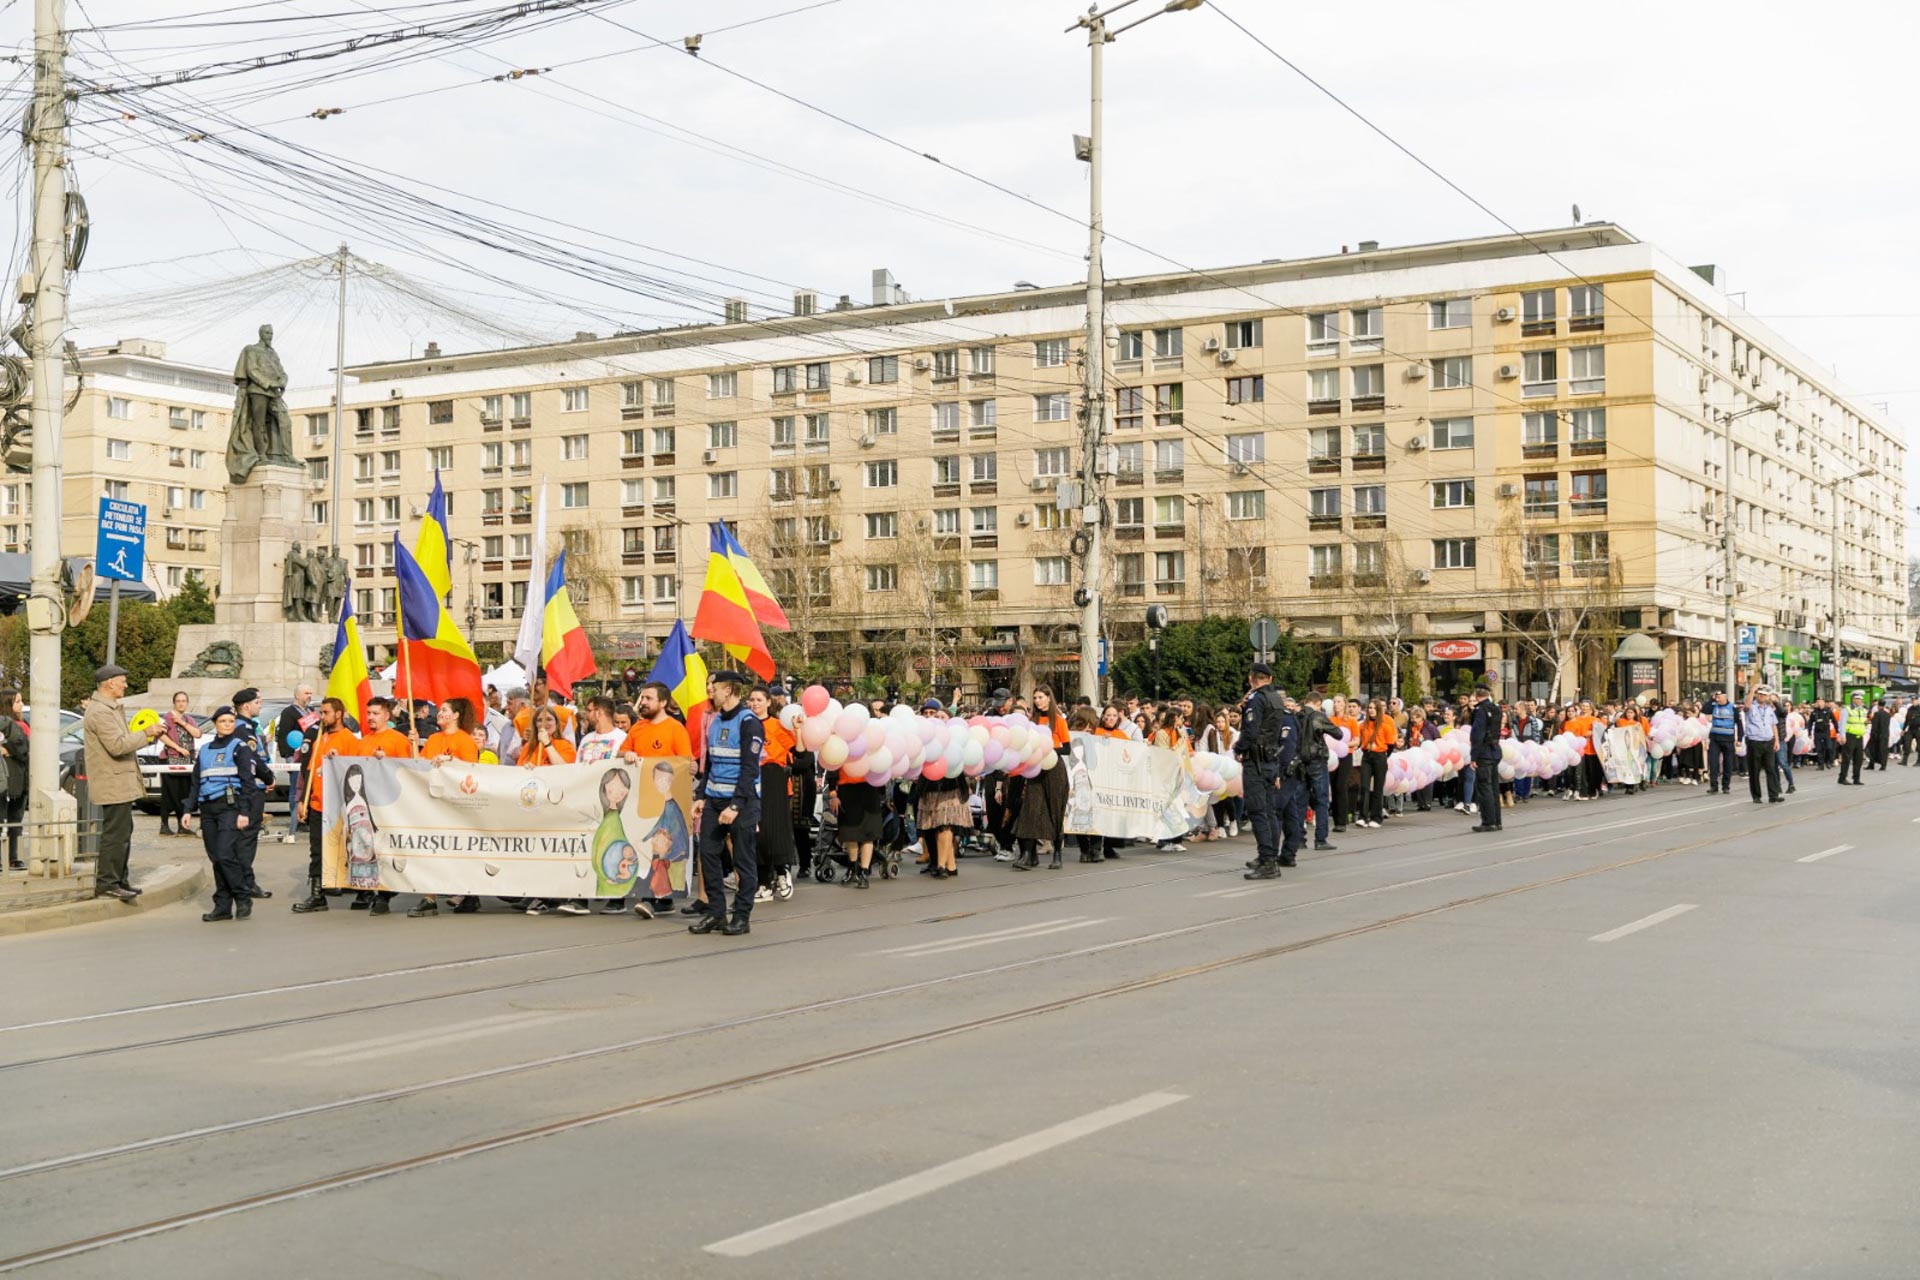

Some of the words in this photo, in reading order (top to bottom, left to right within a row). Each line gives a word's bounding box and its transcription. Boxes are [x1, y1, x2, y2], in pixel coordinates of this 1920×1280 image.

[115, 522, 127, 532] PRIN
[136, 517, 142, 525] SE
[1739, 628, 1750, 643] P
[389, 834, 463, 854] MARȘUL
[467, 835, 536, 853] PENTRU
[540, 834, 588, 857] VIAȚĂ
